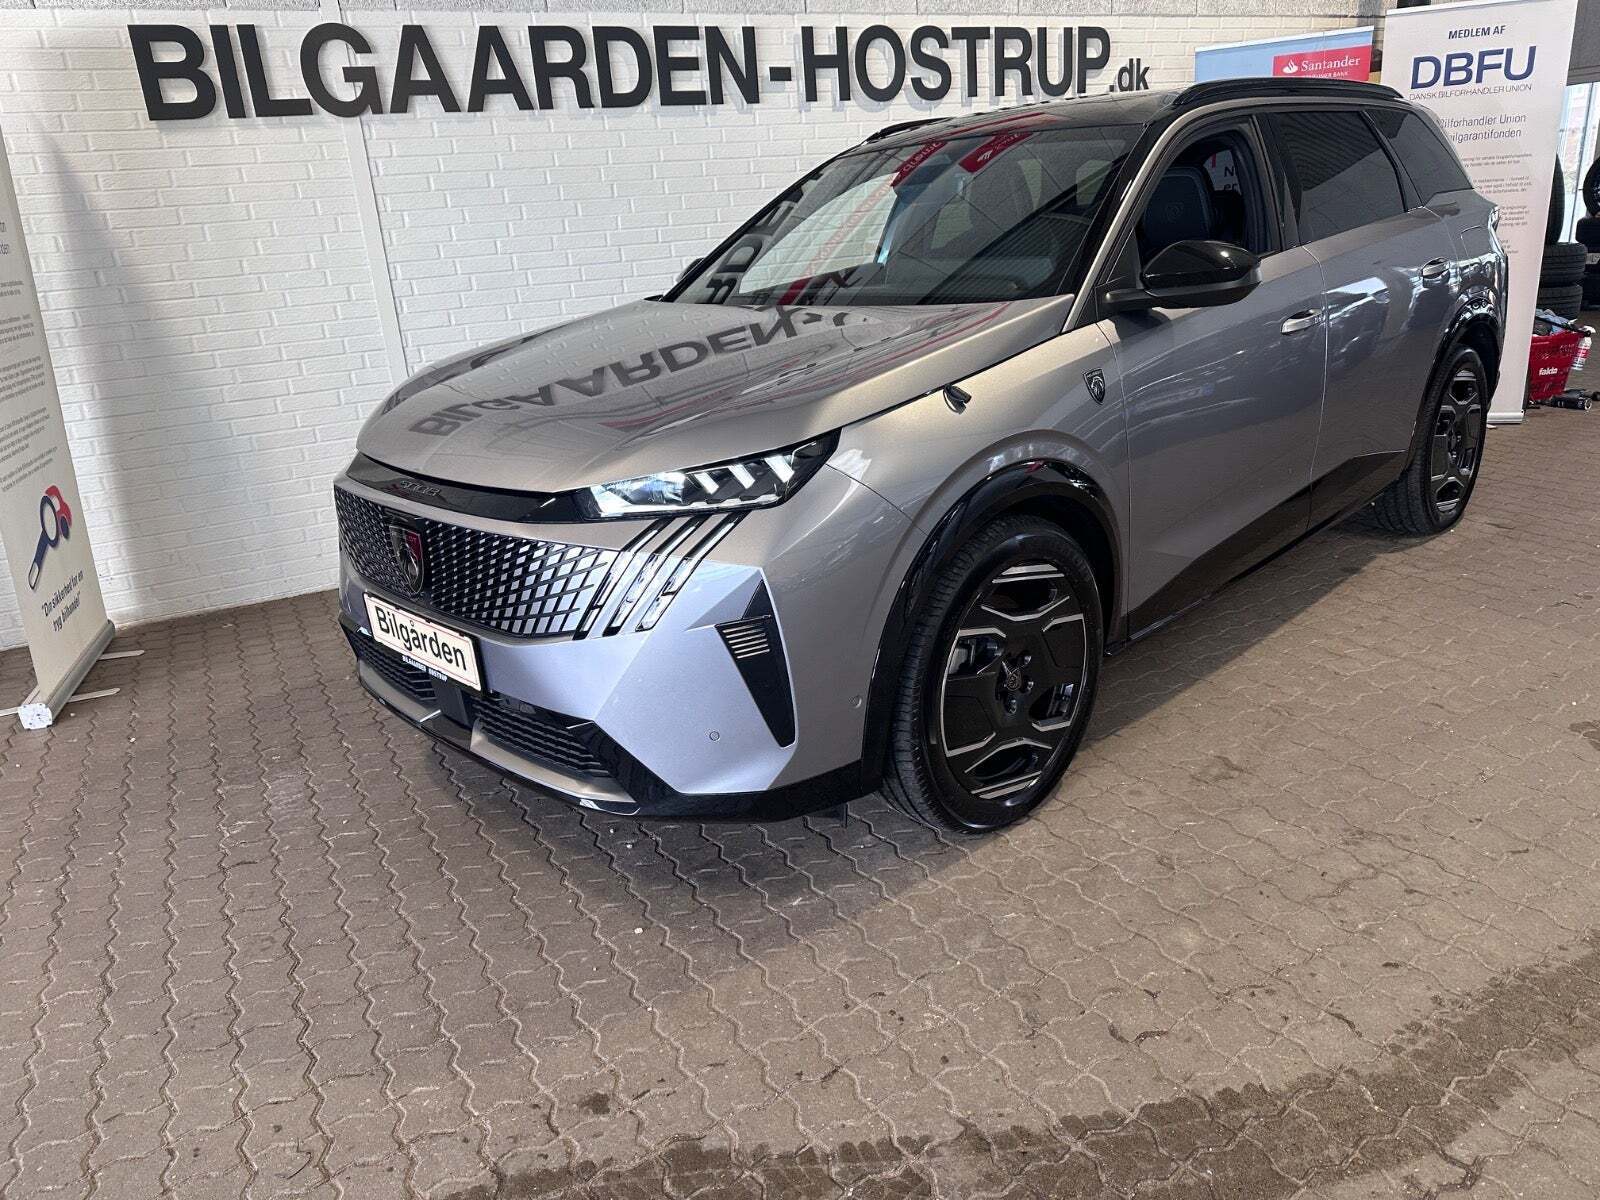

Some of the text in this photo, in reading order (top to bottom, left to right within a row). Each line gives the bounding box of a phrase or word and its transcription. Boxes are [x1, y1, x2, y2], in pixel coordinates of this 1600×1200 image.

[1448, 25, 1506, 39] MEDLEM AF
[1301, 55, 1361, 72] Santander
[1410, 45, 1537, 90] DBFU
[1409, 83, 1533, 101] DANSK BILFORHANDLER UNION
[1499, 114, 1527, 124] Union
[1450, 129, 1522, 144] ilgarantifonden
[375, 604, 468, 672] Bilgården
